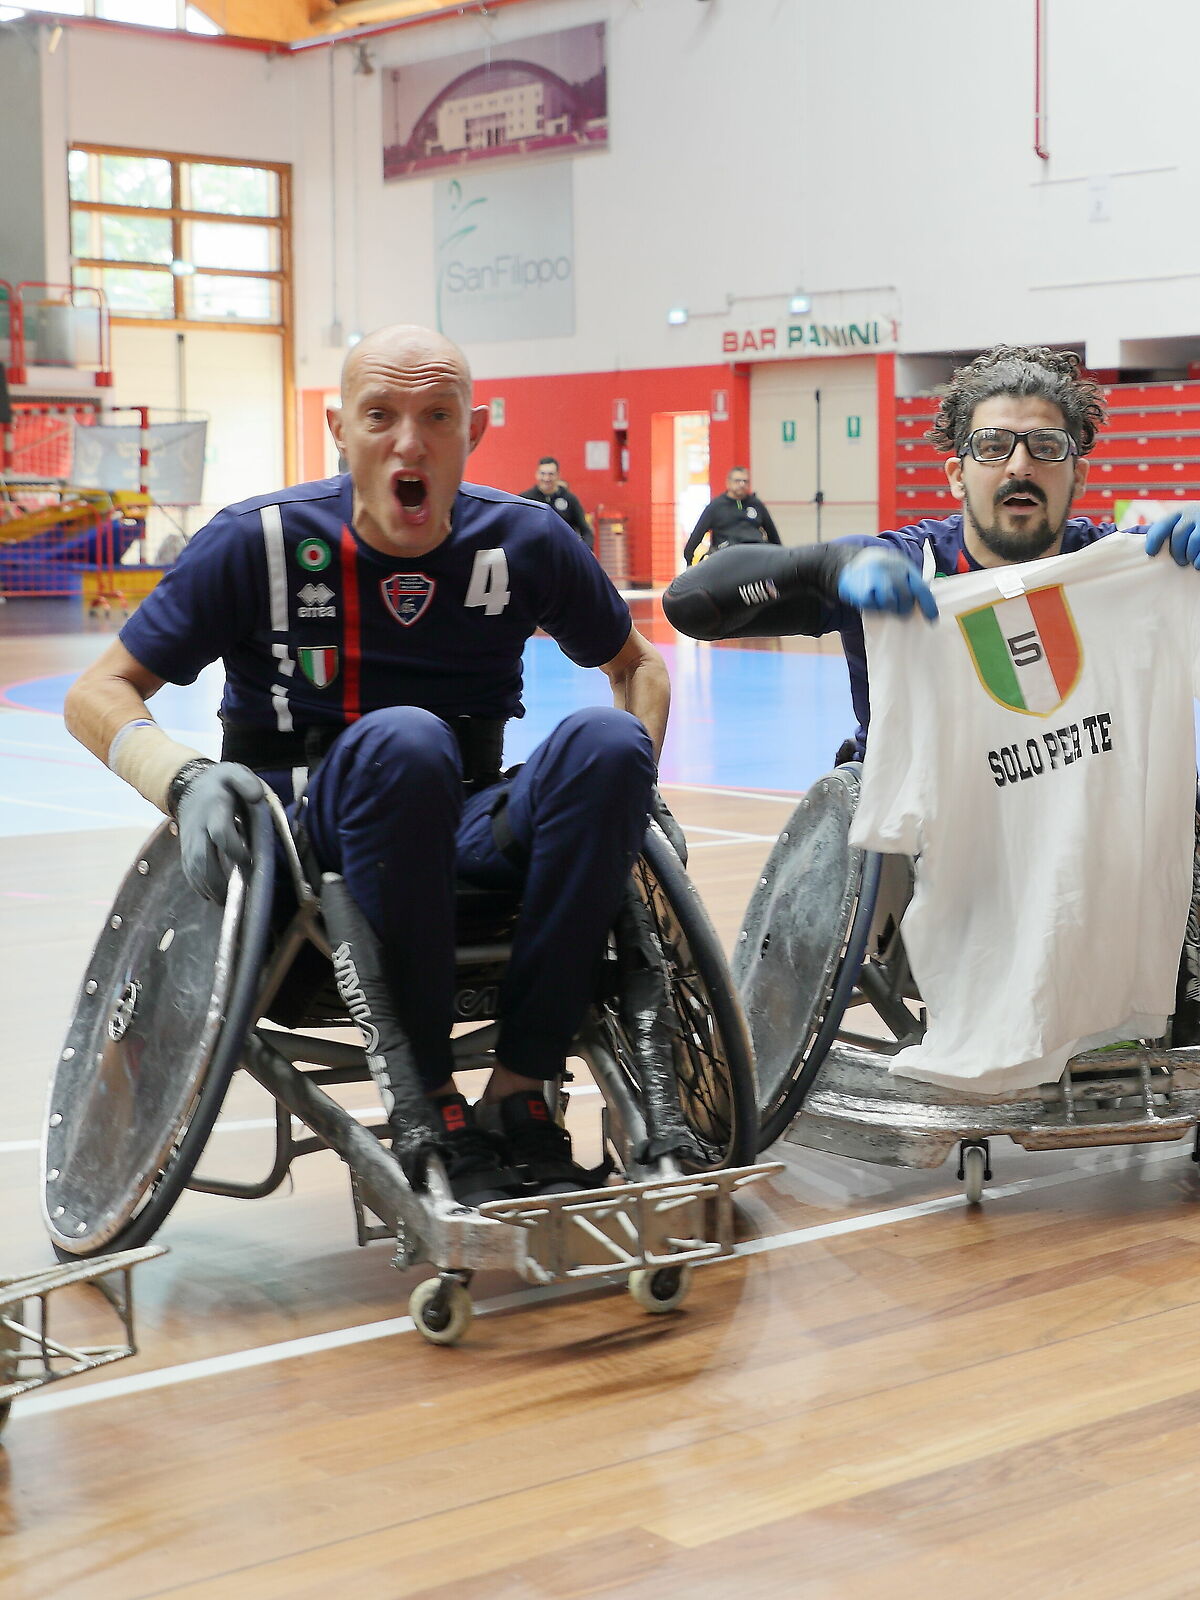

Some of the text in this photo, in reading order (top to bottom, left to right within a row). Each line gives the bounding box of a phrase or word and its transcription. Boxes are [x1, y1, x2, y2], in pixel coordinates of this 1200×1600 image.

[723, 328, 776, 352] BAR
[788, 321, 879, 348] PANINI
[464, 547, 511, 616] 4
[1007, 630, 1042, 667] 5
[988, 713, 1112, 787] SOLO PER TE
